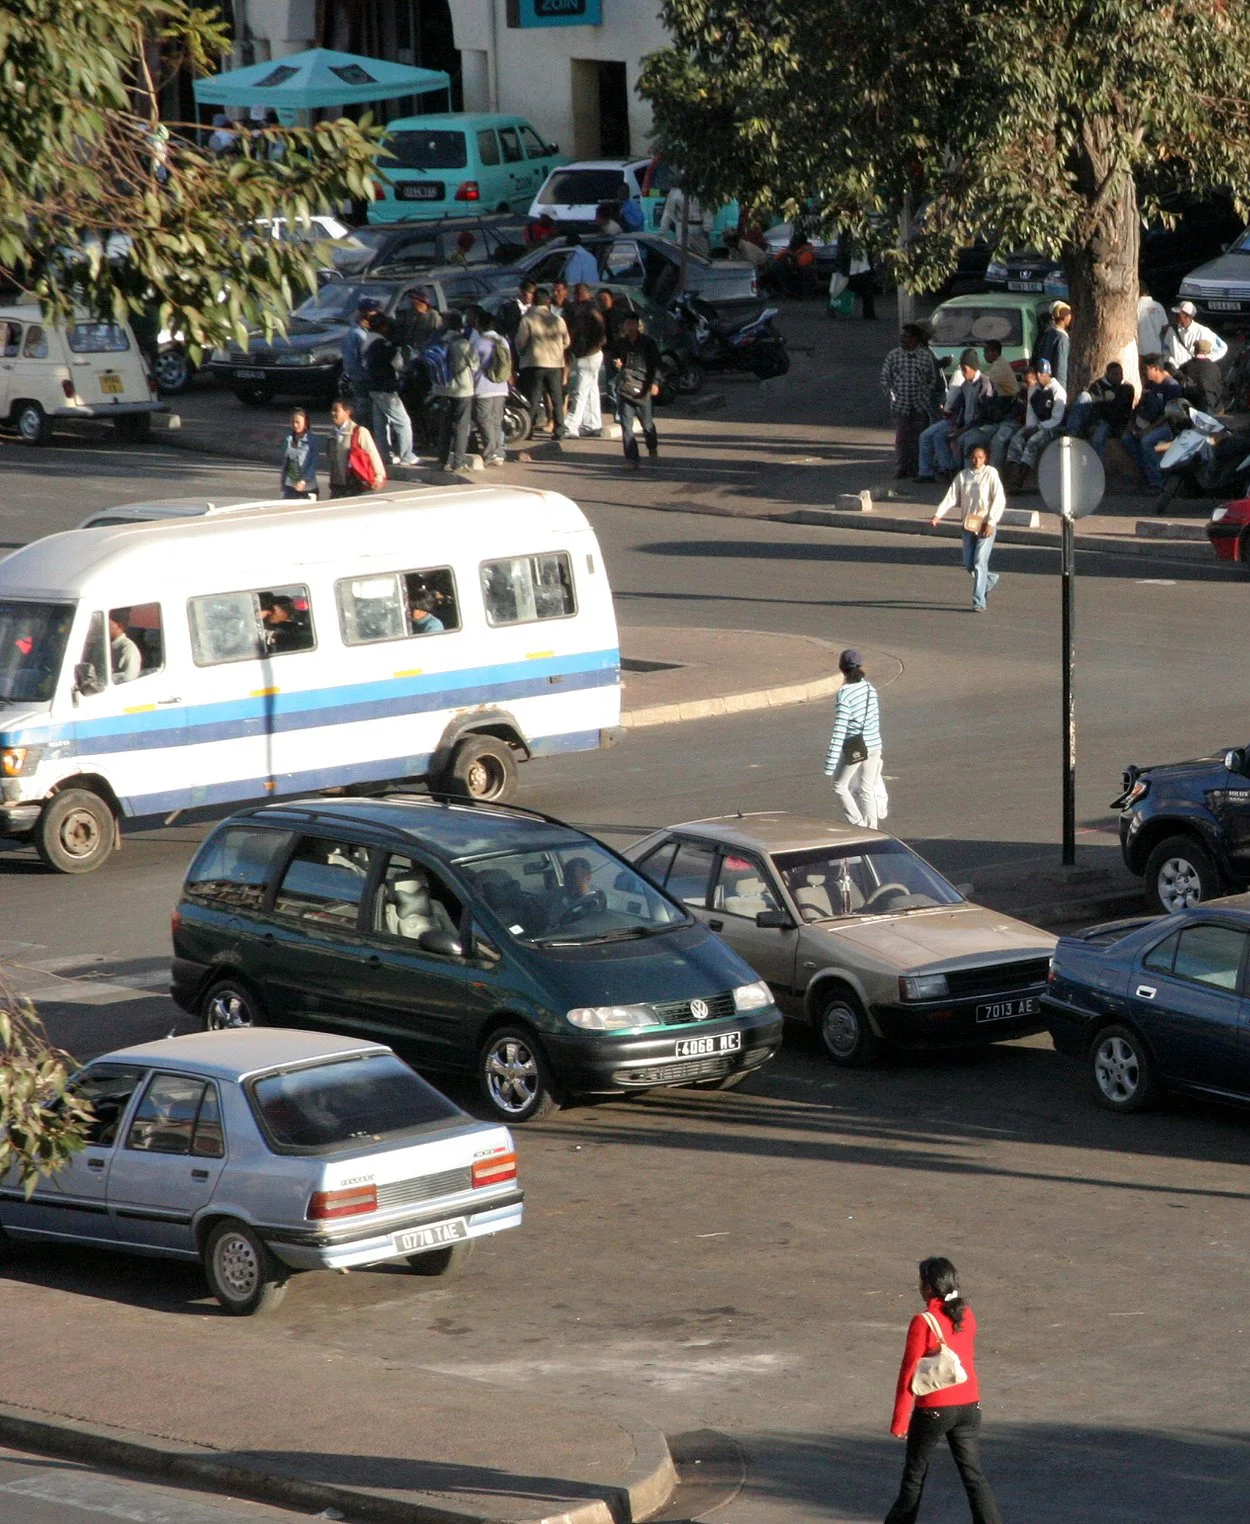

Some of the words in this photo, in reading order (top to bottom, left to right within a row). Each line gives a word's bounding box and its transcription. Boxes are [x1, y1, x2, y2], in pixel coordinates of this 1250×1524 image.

[985, 1002, 1012, 1018] 7013
[1017, 999, 1033, 1014] AE
[681, 1038, 714, 1055] 4068
[435, 1223, 460, 1242] TAE
